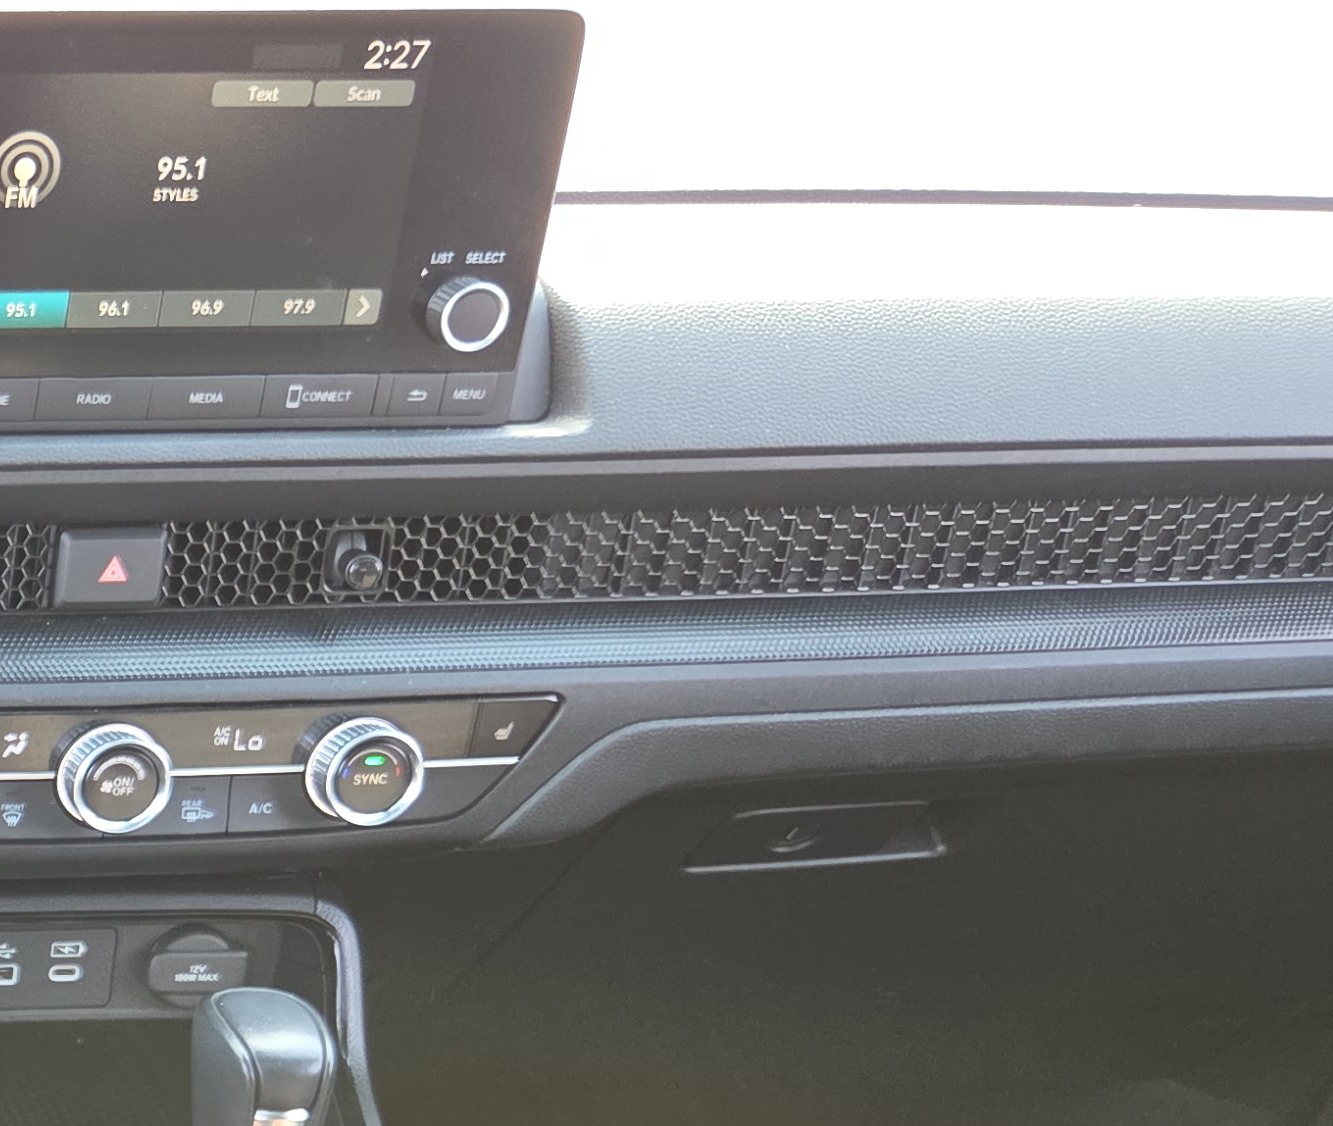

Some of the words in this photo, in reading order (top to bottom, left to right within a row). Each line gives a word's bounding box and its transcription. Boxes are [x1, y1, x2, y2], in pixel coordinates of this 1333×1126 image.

[363, 39, 431, 70] 2:27
[247, 84, 280, 103] Text
[347, 85, 382, 102] Scan
[156, 155, 207, 181] 95.1
[4, 184, 39, 209] FM
[151, 186, 200, 202] STYLES
[430, 252, 454, 264] LIST
[465, 252, 506, 264] SELECT
[5, 302, 37, 318] 95.1
[98, 299, 130, 317] 96.1
[191, 299, 224, 316] 96.9
[283, 298, 316, 315] 97.9
[76, 392, 111, 404] RADIO
[189, 392, 223, 404] MEDIA
[302, 389, 352, 402] CONNECT
[453, 388, 486, 400] MENU
[214, 726, 231, 737] A/C
[213, 736, 229, 746] ON
[233, 728, 264, 751] Lo
[114, 776, 135, 787] ON/
[352, 773, 388, 786] SYNC
[112, 786, 134, 797] OFF
[0, 803, 25, 811] FRONT
[248, 803, 273, 814] A/C
